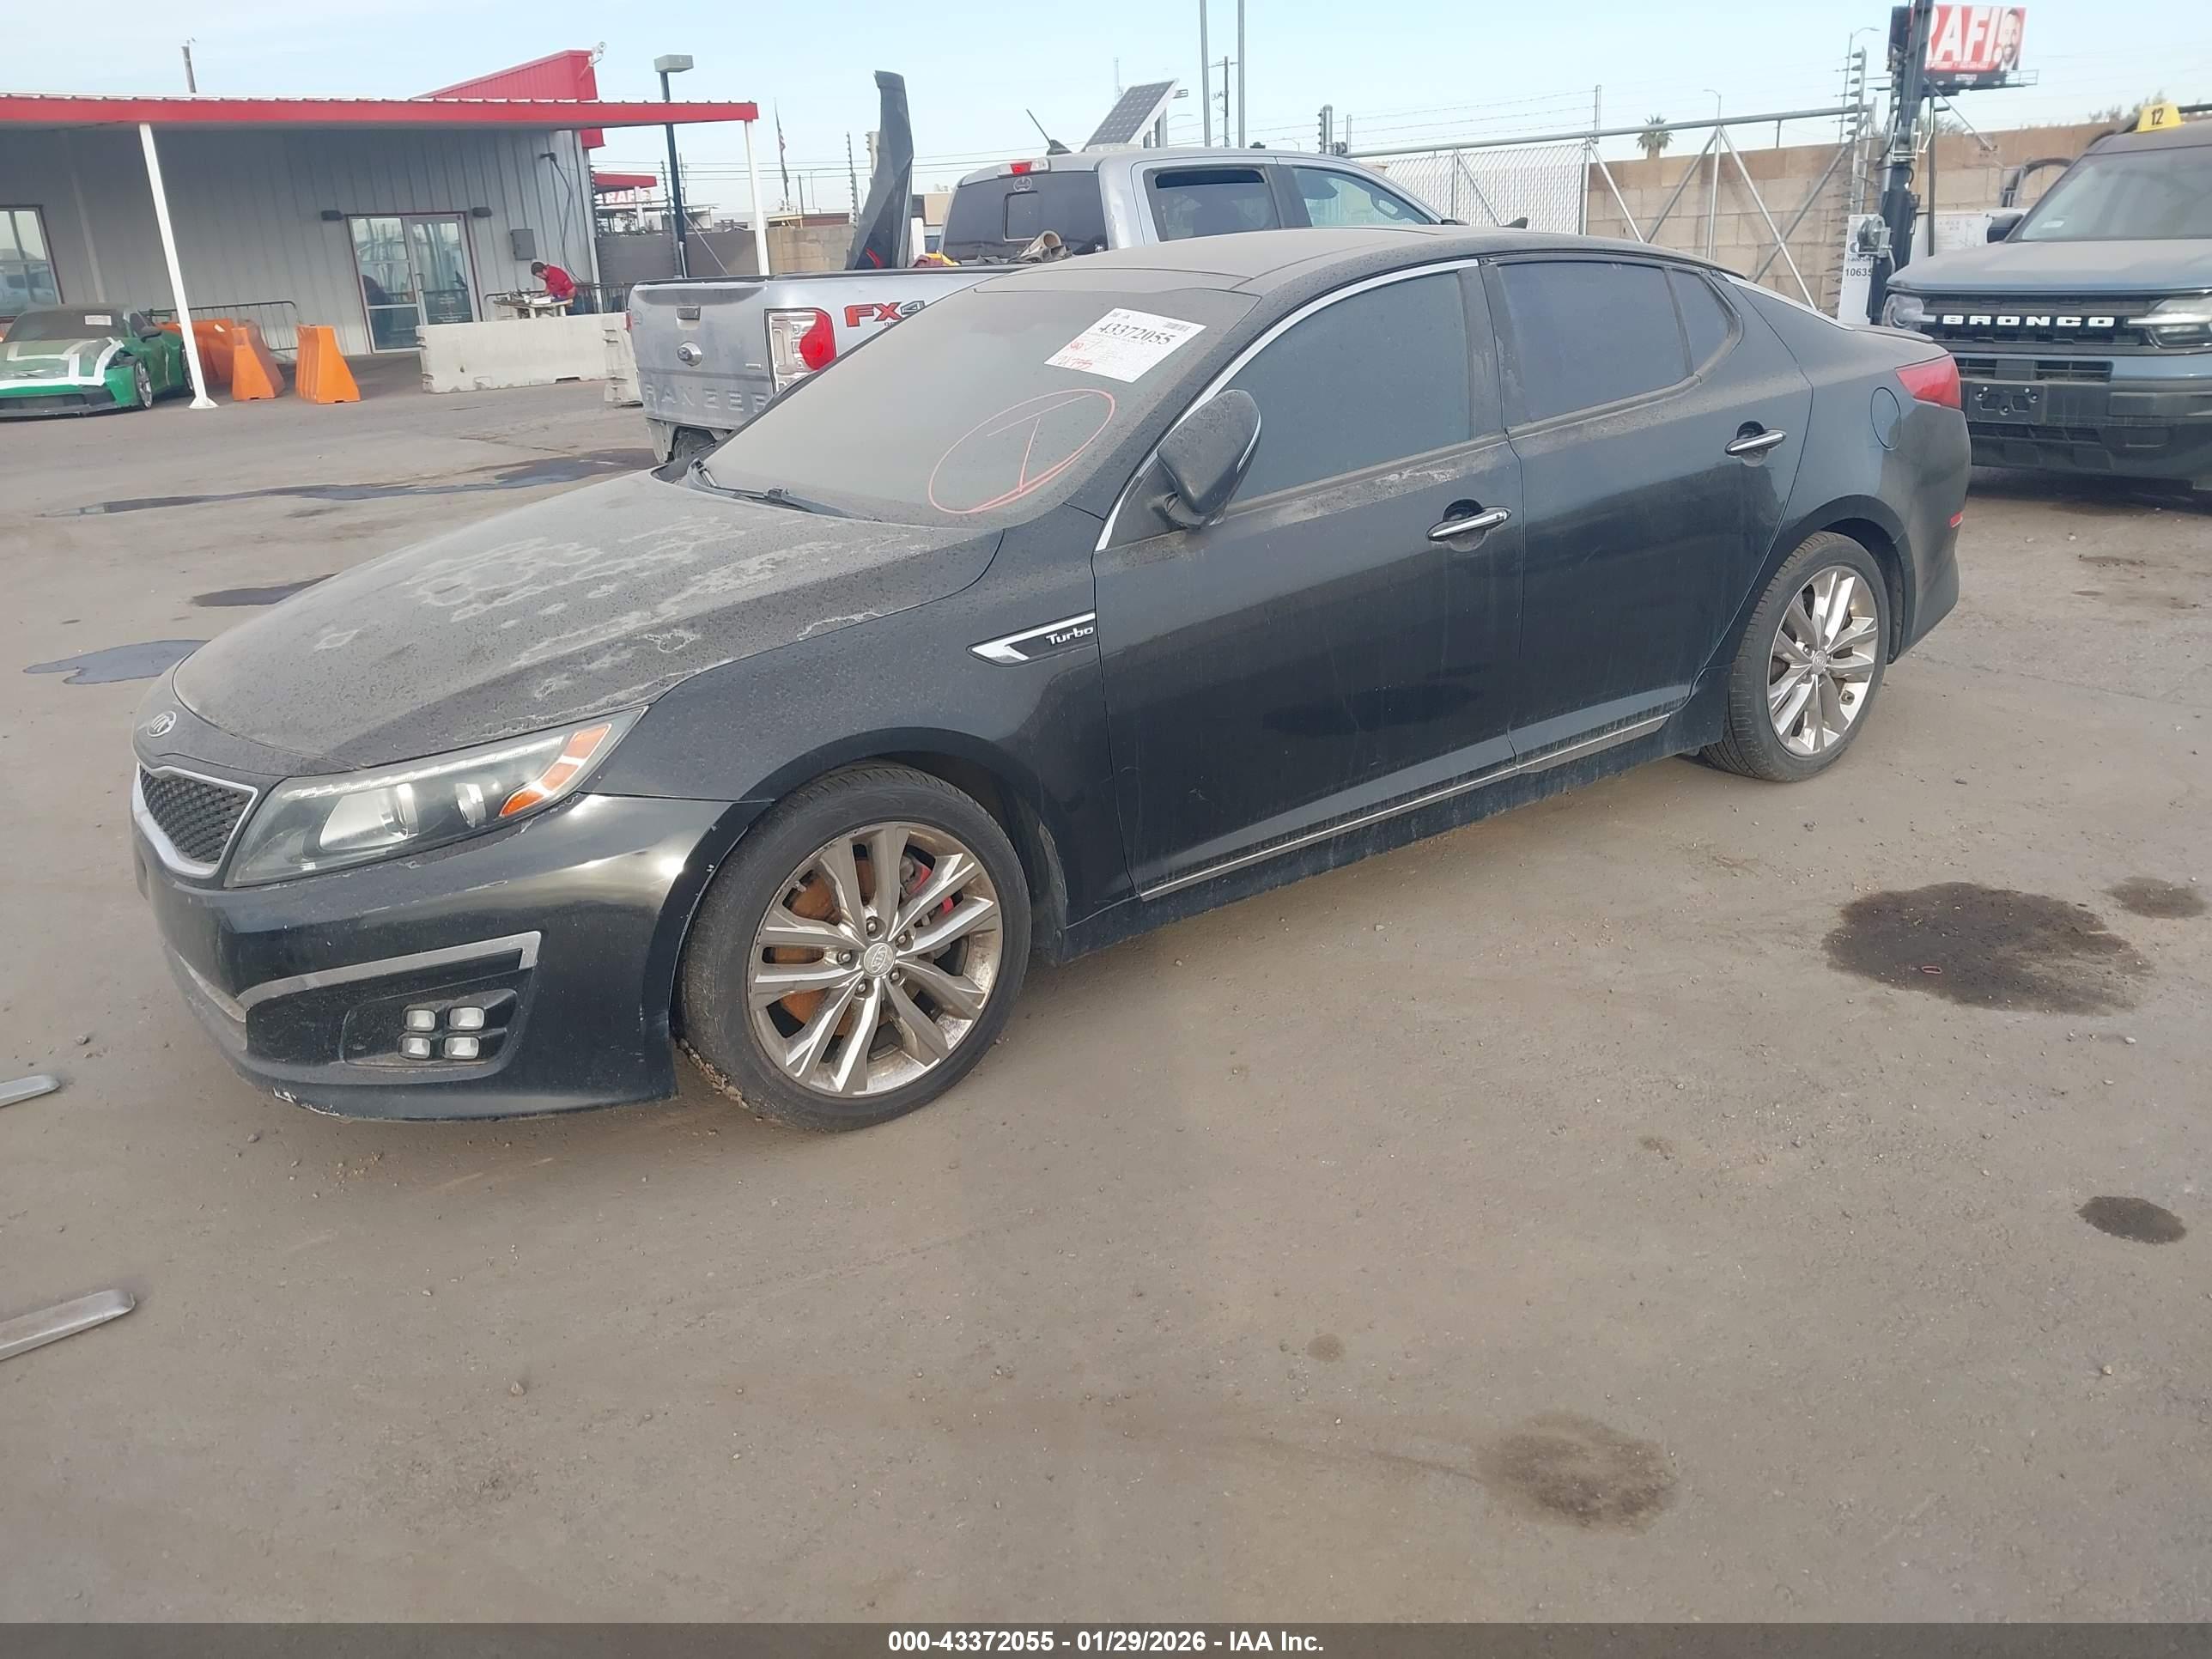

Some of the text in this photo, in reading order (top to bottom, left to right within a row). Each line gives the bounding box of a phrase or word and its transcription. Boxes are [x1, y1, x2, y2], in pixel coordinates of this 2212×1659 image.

[2151, 107, 2165, 126] 12
[844, 301, 925, 327] FX4
[1942, 314, 2115, 327] BRONCO
[1099, 323, 1176, 344] 43372055
[1045, 626, 1094, 646] Turbo
